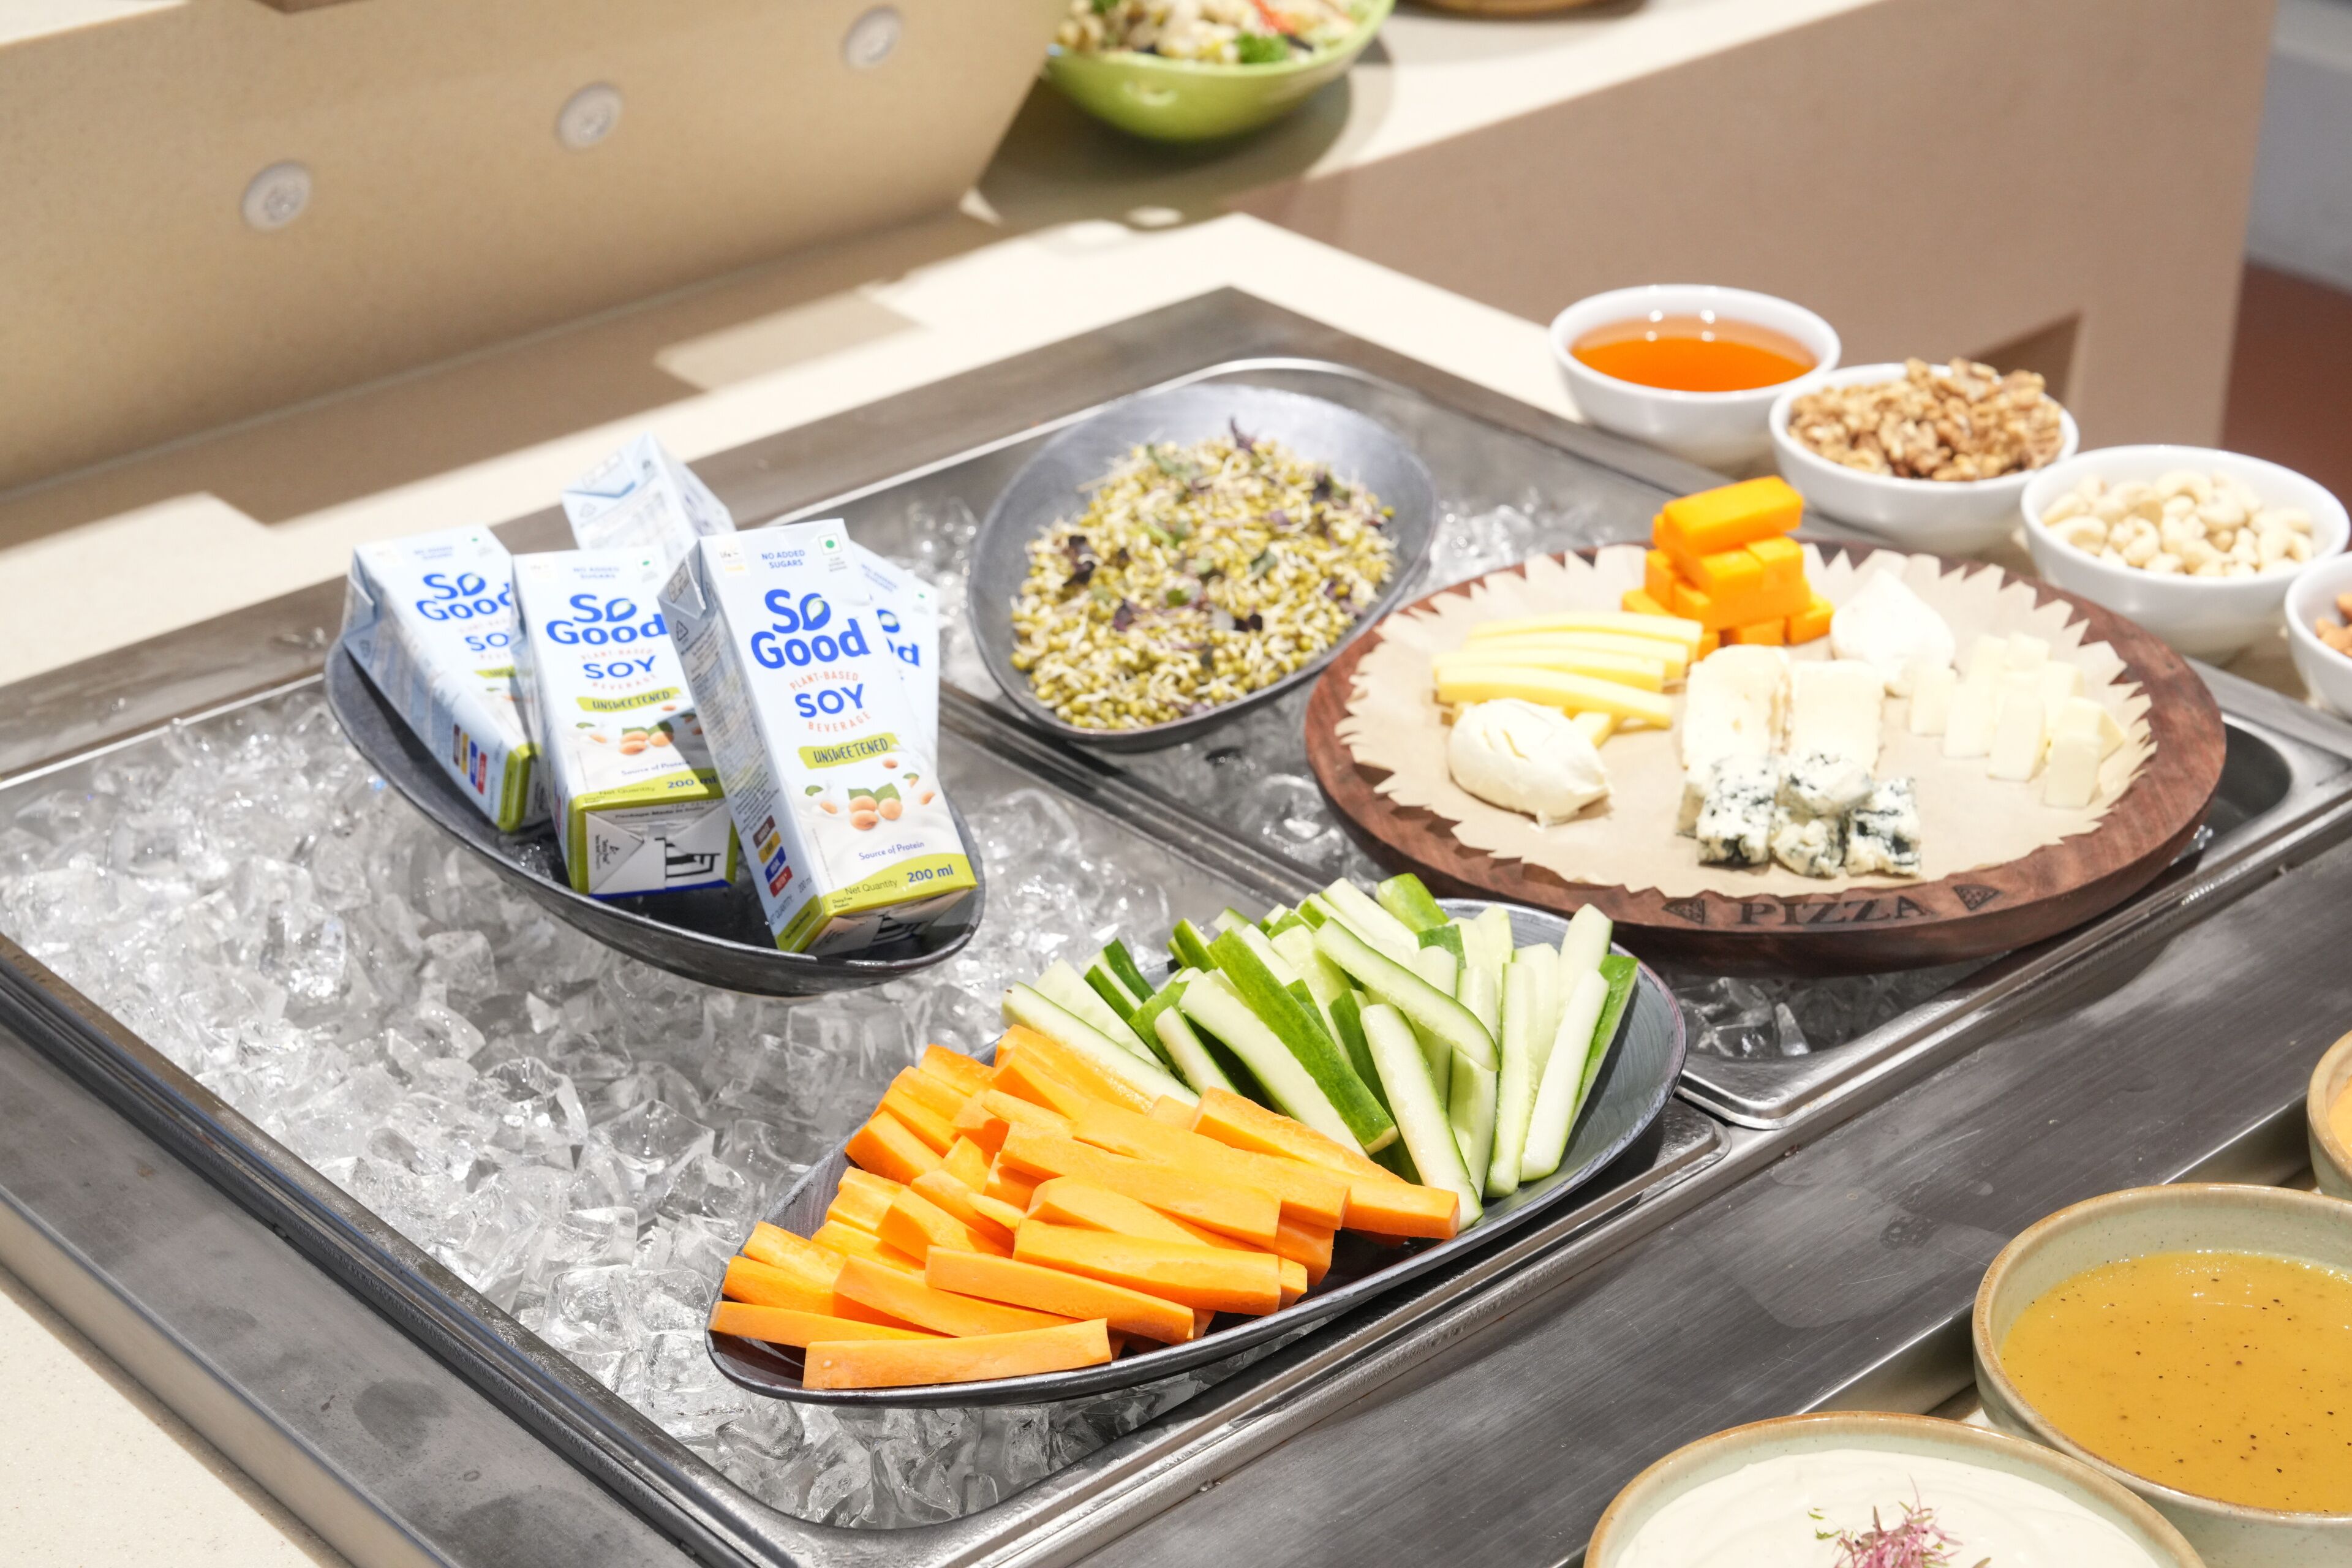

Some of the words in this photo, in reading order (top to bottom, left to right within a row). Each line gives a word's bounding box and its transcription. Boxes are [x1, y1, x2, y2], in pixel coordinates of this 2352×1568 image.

[769, 559, 803, 568] SUGARS
[777, 549, 805, 558] ADDED
[465, 628, 510, 651] SO
[546, 613, 669, 645] Good
[751, 618, 872, 669] Good
[583, 655, 656, 679] SOY
[790, 671, 859, 690] PLANT-BASED
[592, 691, 669, 710] UNSWEETENED
[795, 684, 864, 718] SOY
[809, 711, 871, 732] BEVERAGE
[813, 737, 888, 763] UNSWEETENED
[667, 778, 695, 789] 200
[859, 850, 886, 861] Source
[888, 845, 897, 854] of
[896, 841, 925, 852] Protein
[845, 886, 861, 895] Net
[862, 879, 897, 892] Quantity
[907, 869, 933, 882] 200
[937, 864, 954, 877] ml
[1737, 895, 1934, 925] PIZZA
